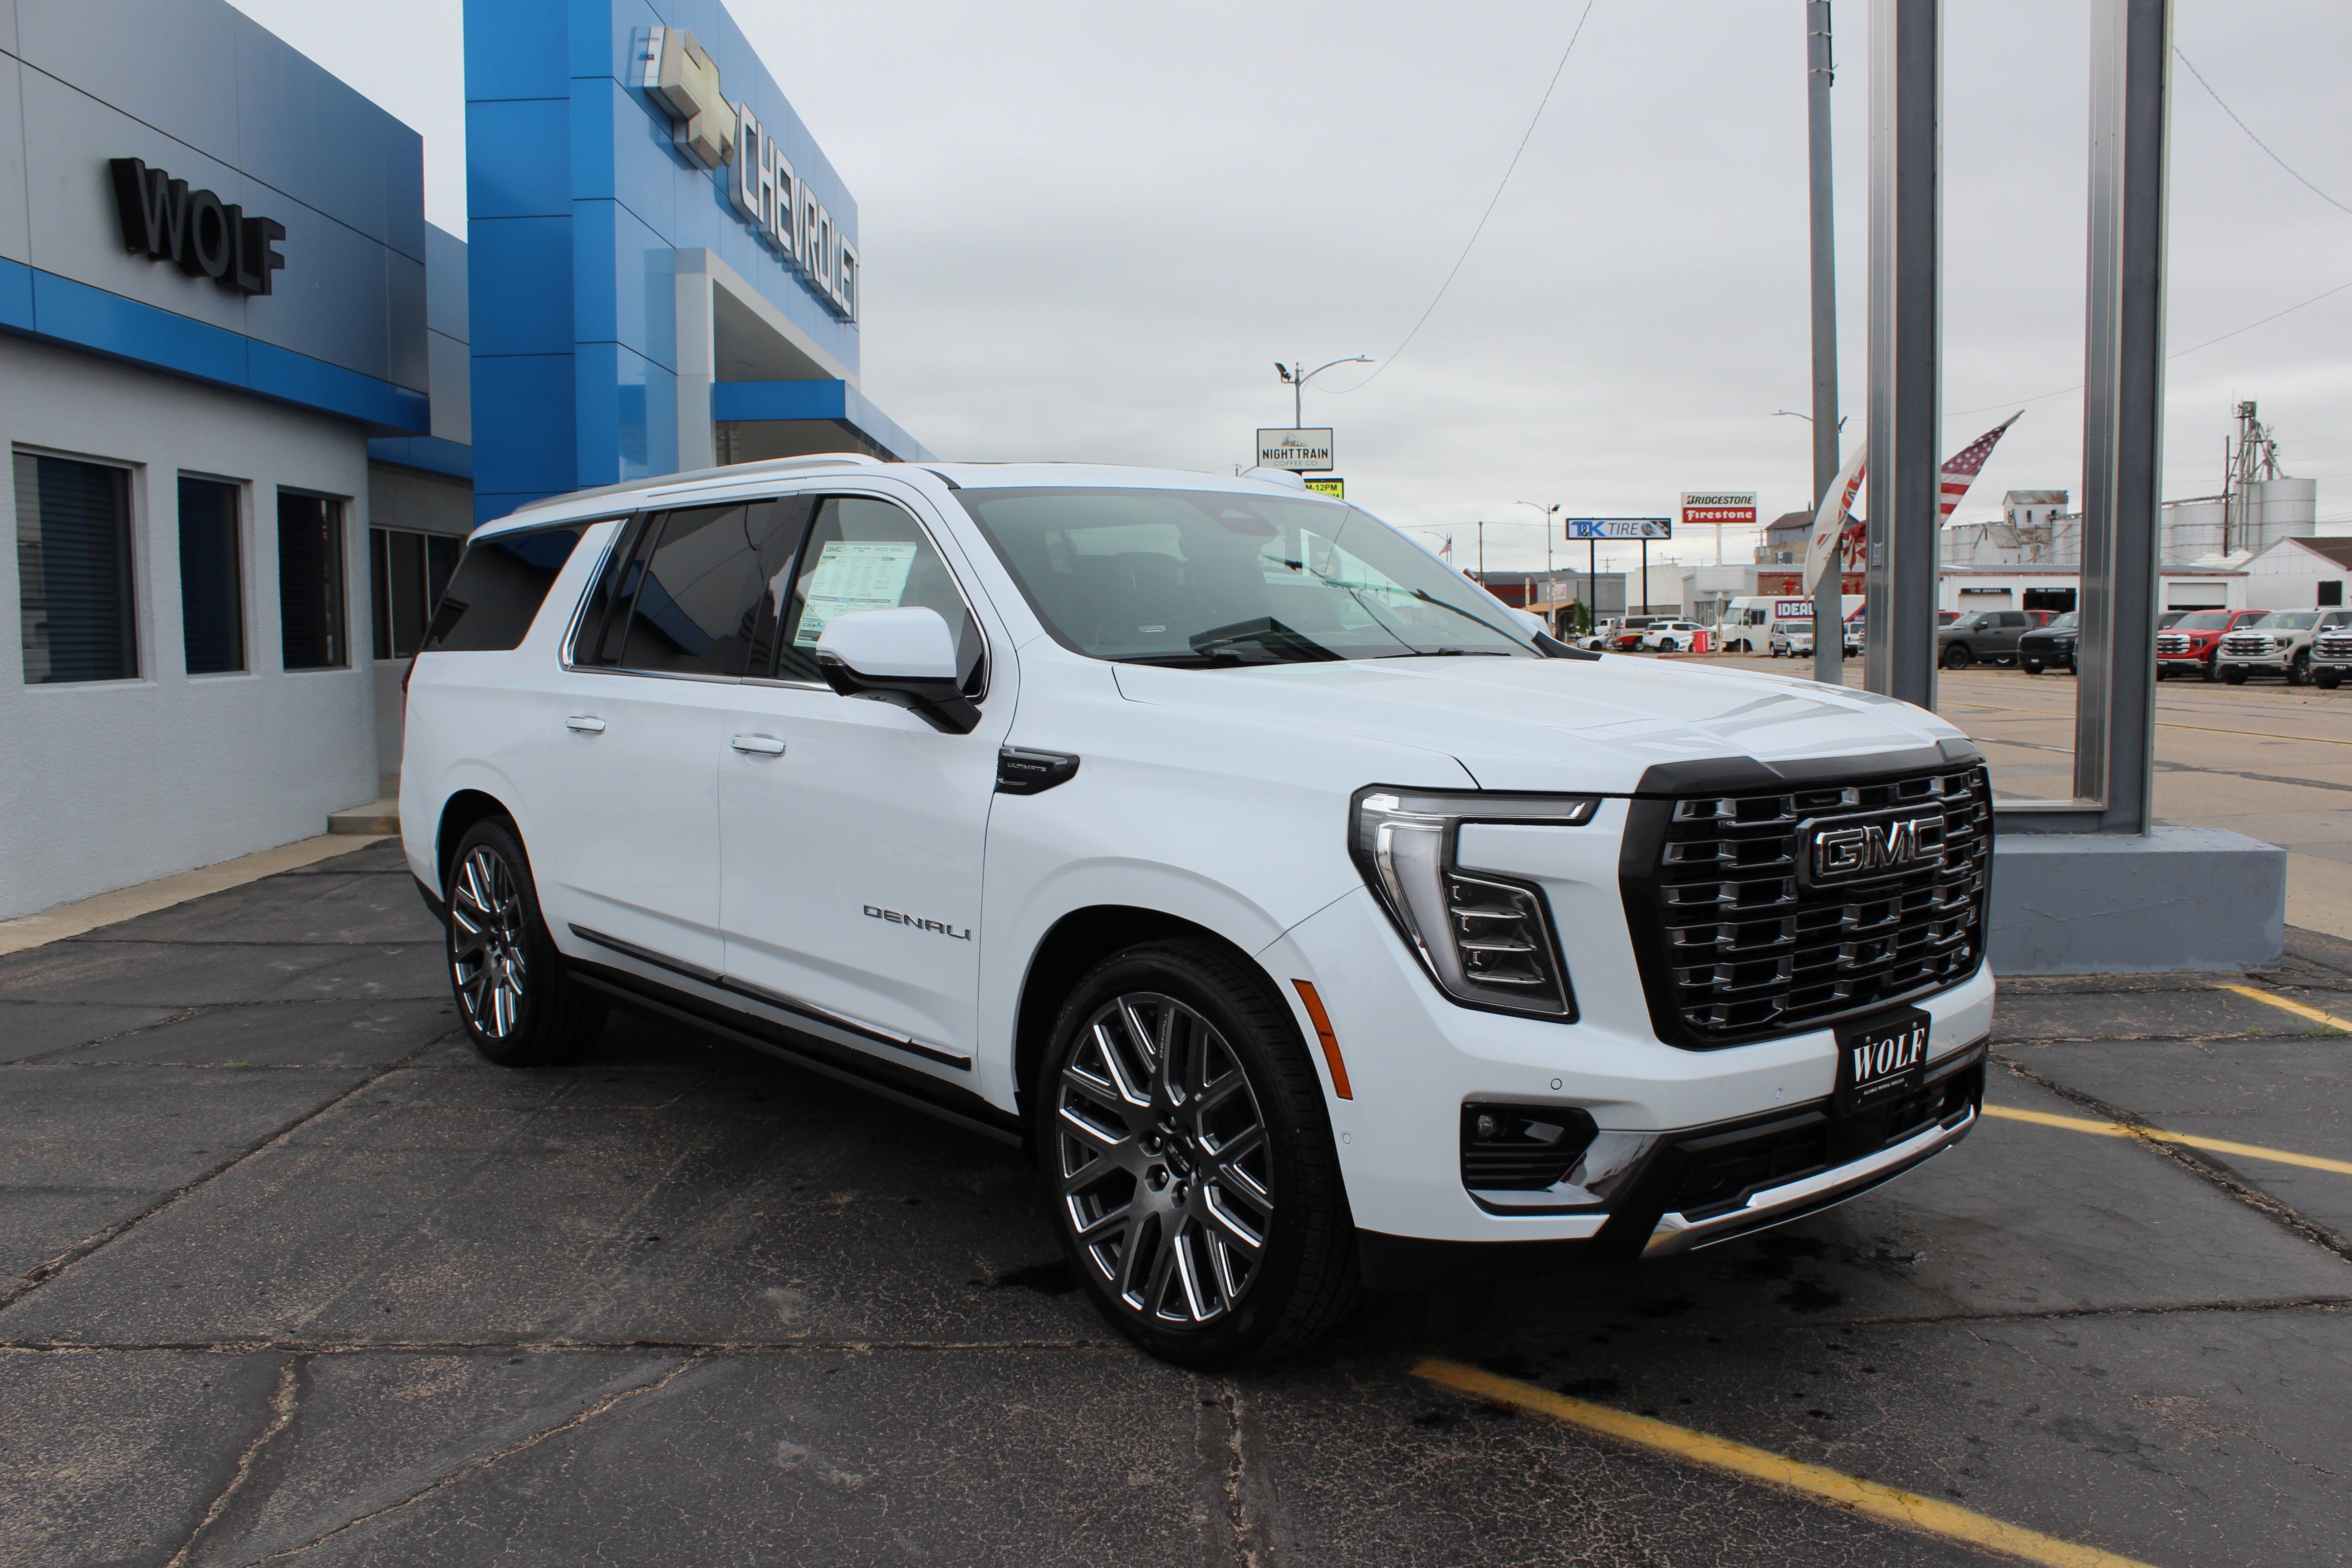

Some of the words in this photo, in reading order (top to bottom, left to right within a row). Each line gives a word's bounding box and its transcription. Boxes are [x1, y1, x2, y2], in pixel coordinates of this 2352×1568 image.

[728, 101, 860, 324] CHEVROLET
[109, 157, 286, 296] WOLF
[1263, 449, 1294, 459] NIGHT
[1296, 448, 1328, 459] TRAIN
[1686, 495, 1753, 504] BRIDGESTONE
[1686, 510, 1753, 521] Firestone
[1570, 521, 1606, 537] T&K
[1608, 523, 1639, 535] TIRE
[1778, 603, 1814, 616] IDEAL
[1007, 762, 1046, 772] ULTIMATE
[1816, 815, 1945, 877] GMC
[863, 904, 971, 941] DENALI
[1853, 1028, 1925, 1082] WOLF
